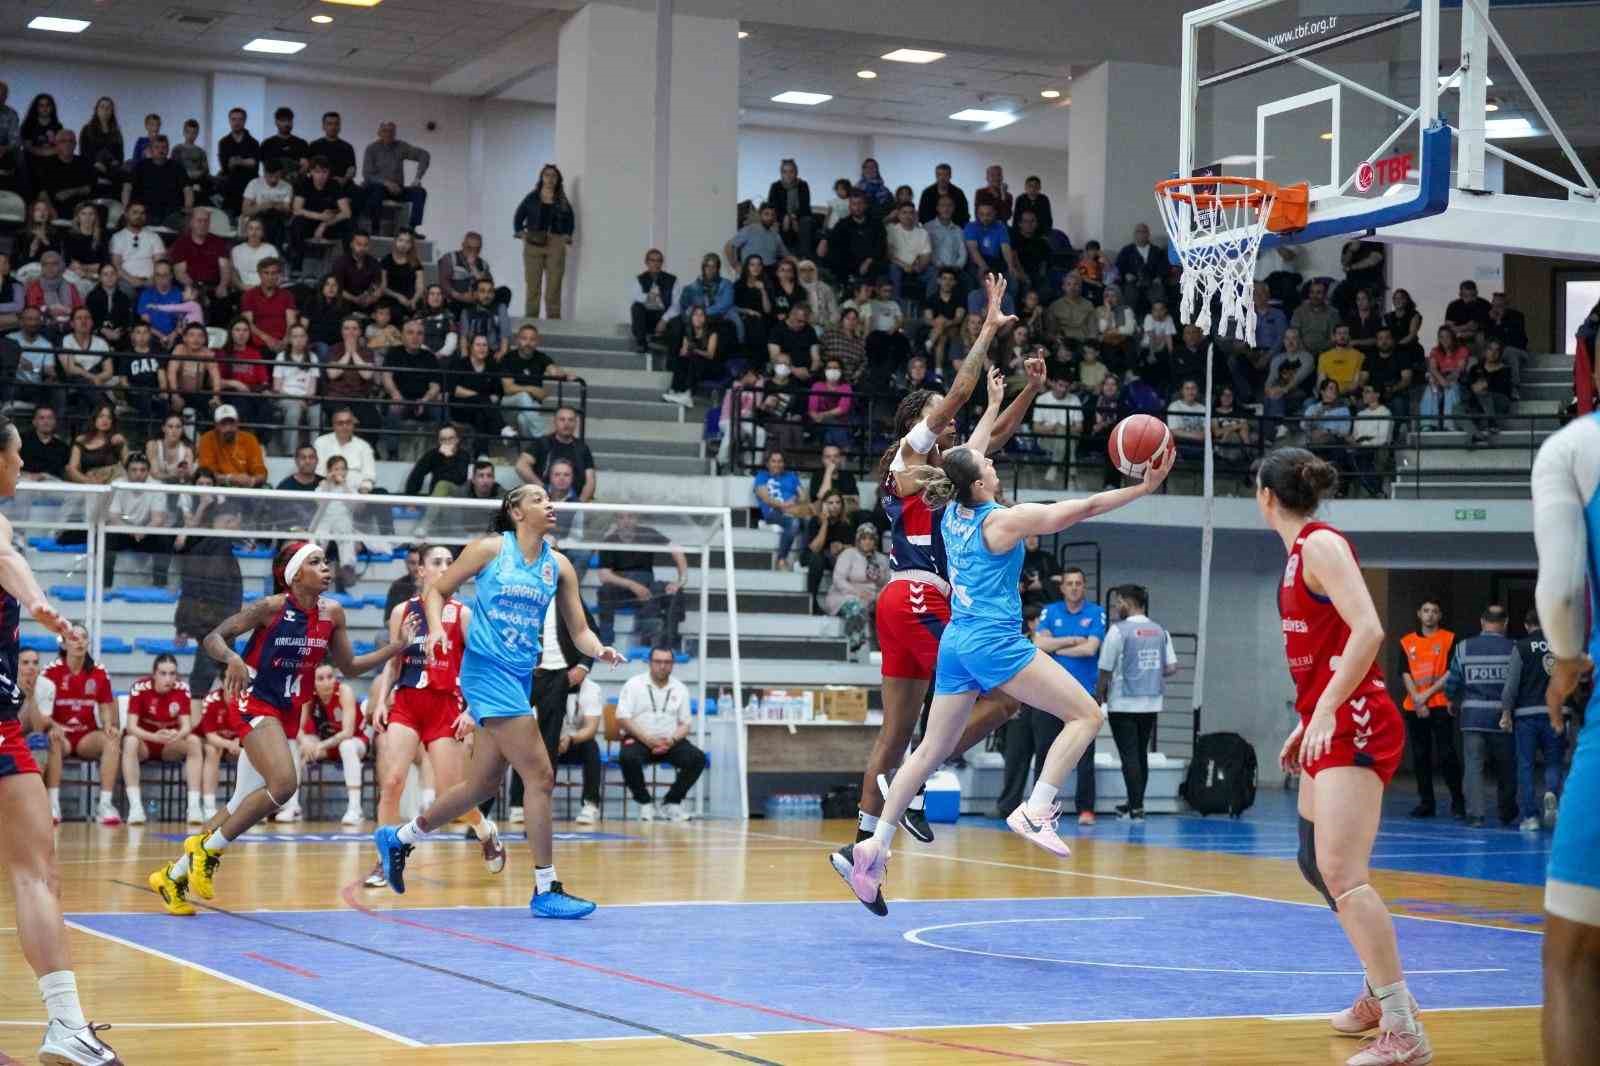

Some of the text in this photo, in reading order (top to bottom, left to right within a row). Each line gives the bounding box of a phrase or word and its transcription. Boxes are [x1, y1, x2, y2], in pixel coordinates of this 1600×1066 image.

[1266, 15, 1337, 48] www.tbf.org.tr
[1376, 153, 1413, 187] TBF
[284, 674, 304, 698] 14
